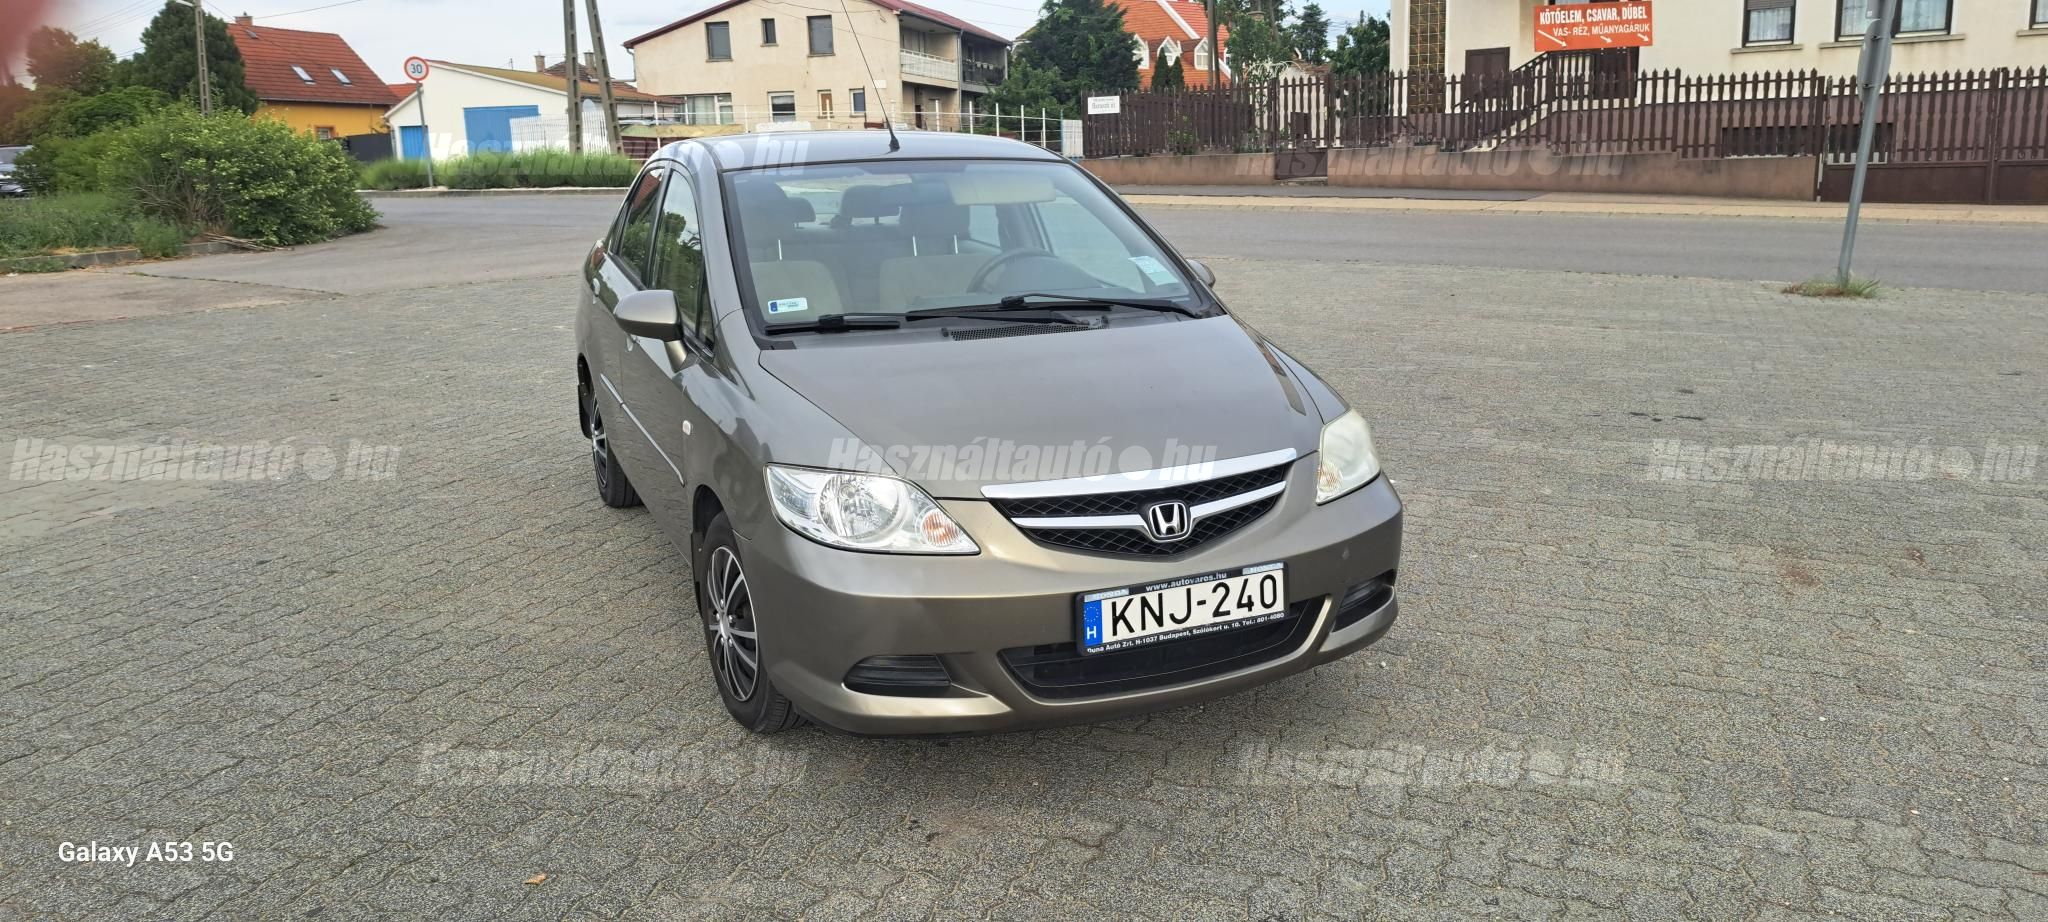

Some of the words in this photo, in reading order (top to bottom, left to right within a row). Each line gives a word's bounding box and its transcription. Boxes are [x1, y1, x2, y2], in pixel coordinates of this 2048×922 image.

[1586, 6, 1620, 22] CSAVAR,
[411, 64, 422, 73] 30
[1111, 574, 1277, 637] KNJ-240
[1086, 625, 1097, 640] H
[1135, 636, 1157, 645] H-1037
